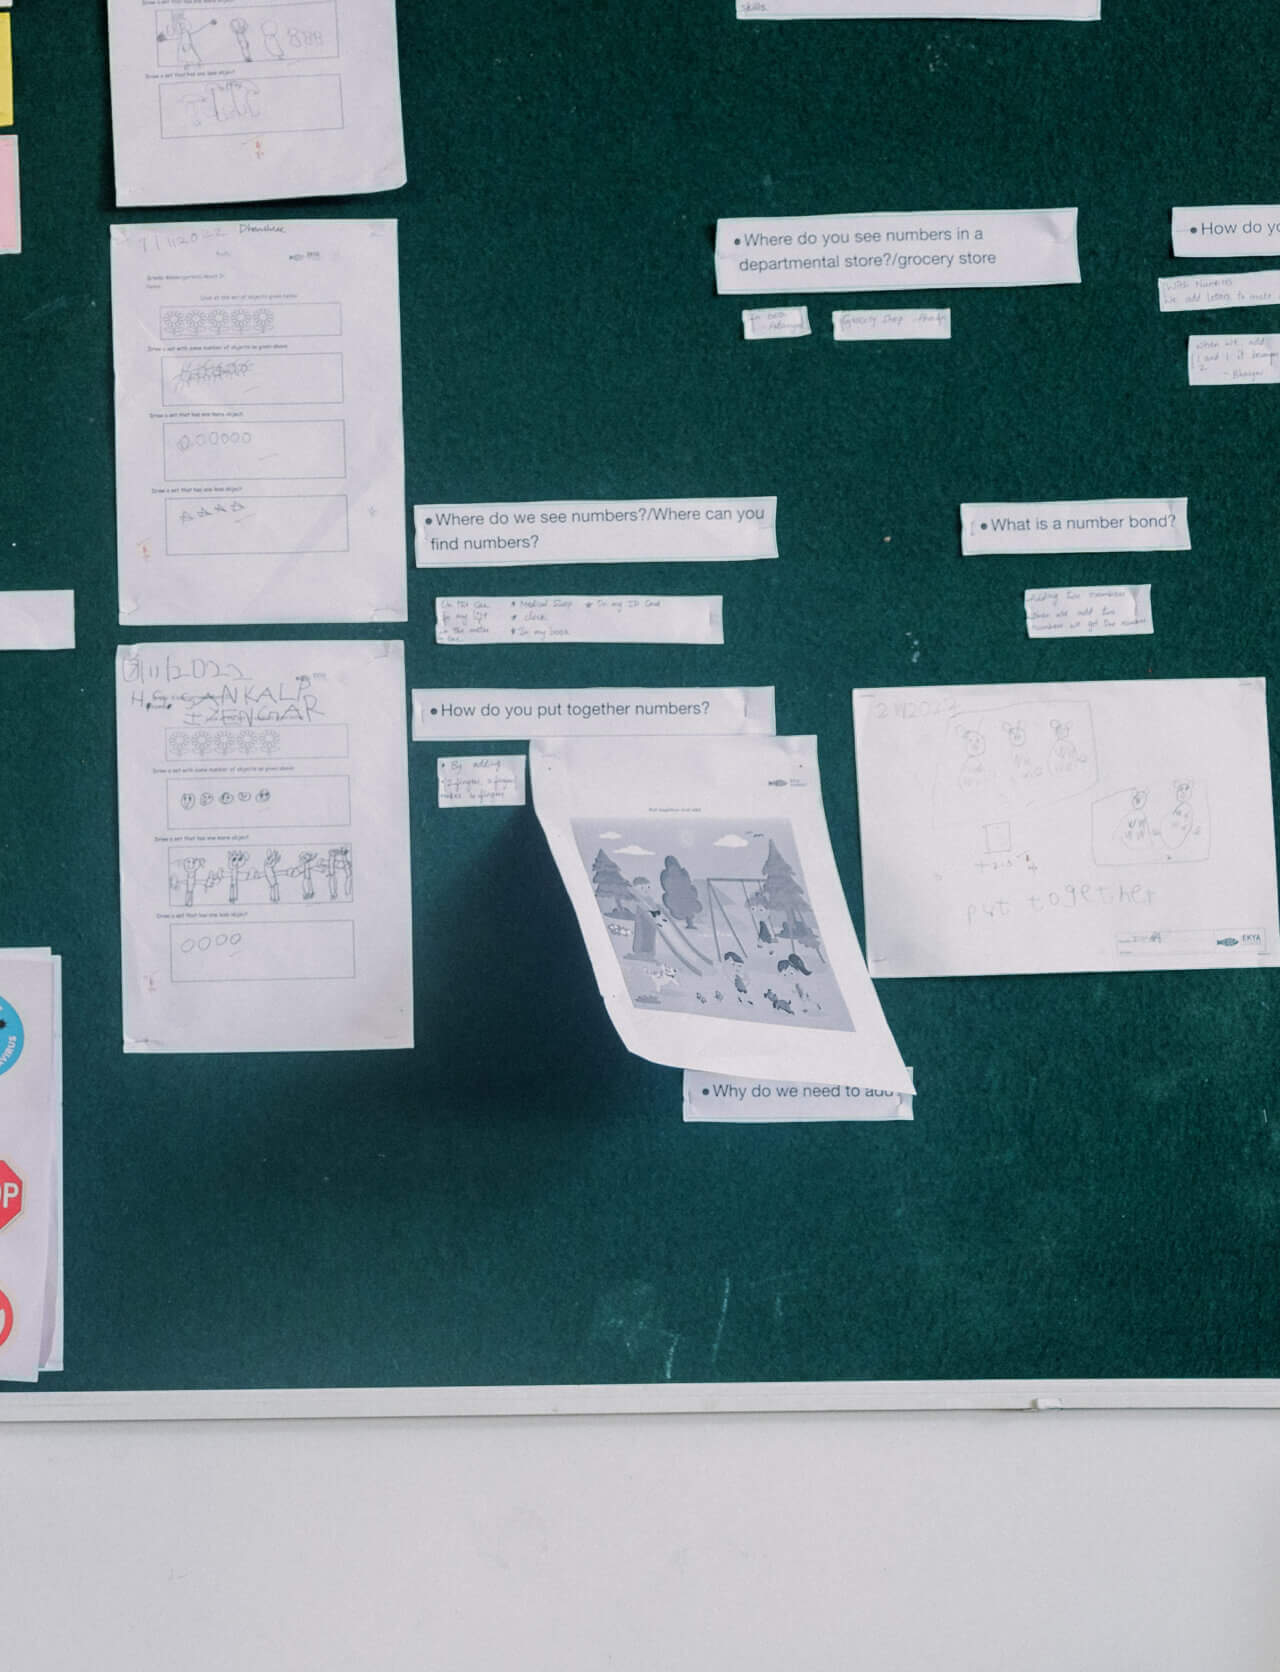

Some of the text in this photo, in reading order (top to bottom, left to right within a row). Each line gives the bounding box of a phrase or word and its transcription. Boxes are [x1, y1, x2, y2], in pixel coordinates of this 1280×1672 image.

[1201, 222, 1236, 235] How
[1242, 221, 1262, 234] do
[744, 228, 983, 248] Where do you see numbers in a
[739, 252, 996, 272] departmental store?/grocery store
[436, 508, 764, 526] Where do we see numbers?/Where can you
[991, 515, 1176, 531] What is a number bond?
[430, 535, 539, 550] find numbers?
[441, 701, 710, 719] How do you put together numbers?
[713, 1084, 746, 1100] Why
[751, 1085, 770, 1097] do
[776, 1087, 799, 1097] we
[803, 1086, 840, 1097] need
[846, 1086, 860, 1097] to
